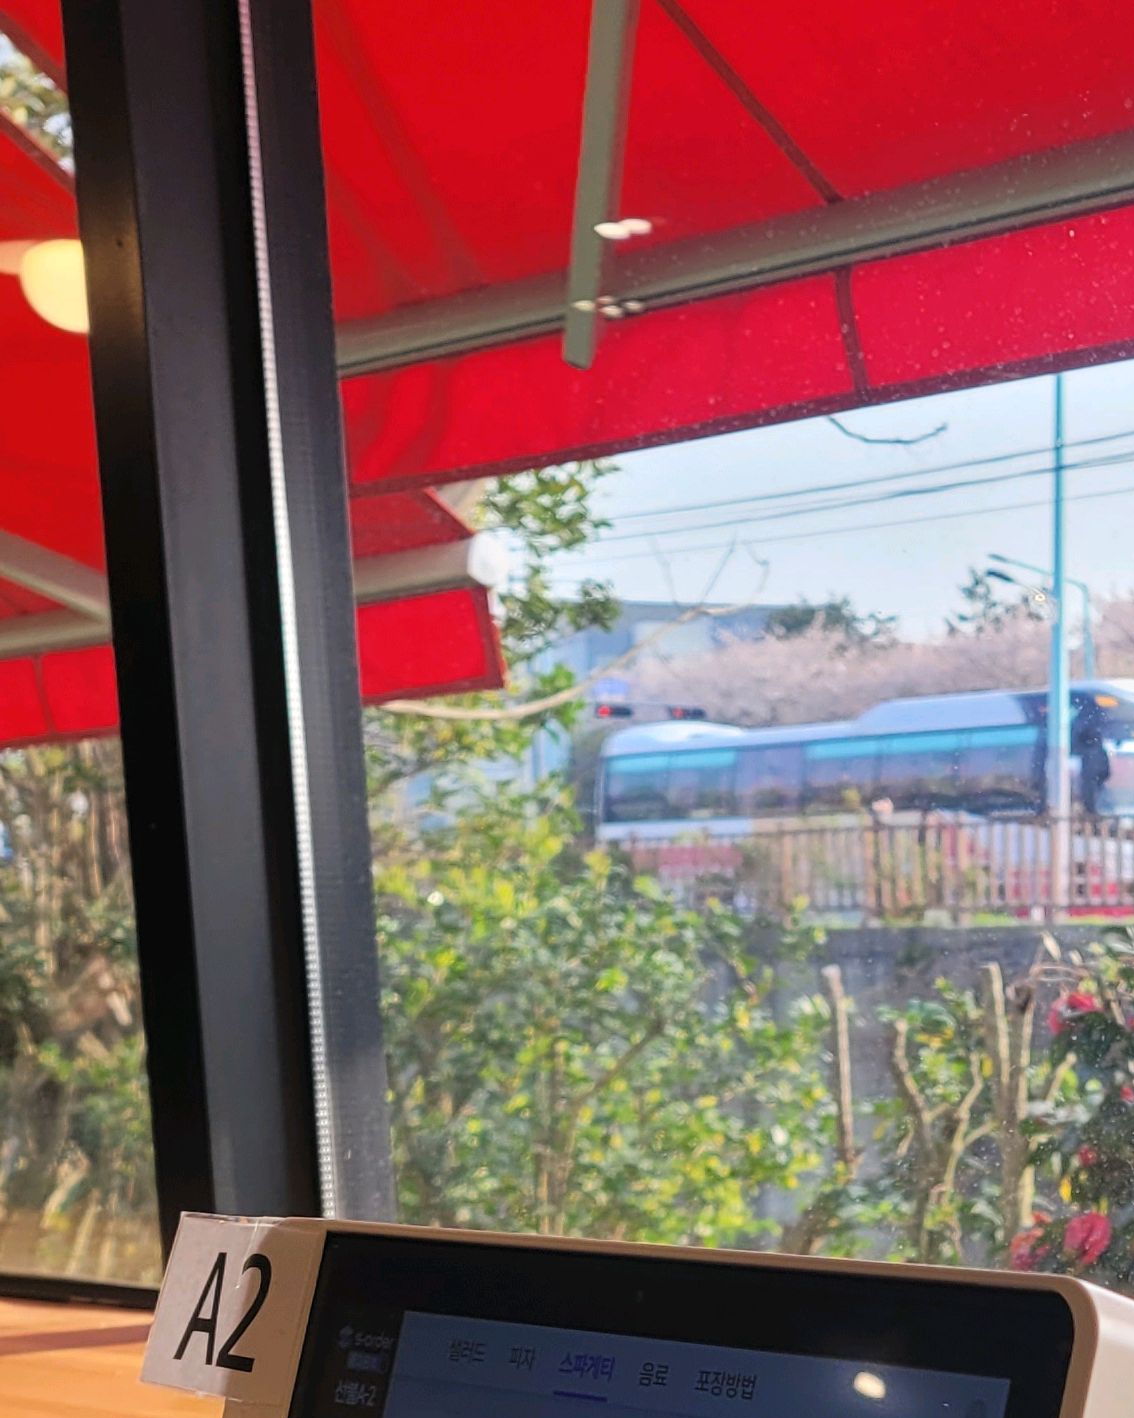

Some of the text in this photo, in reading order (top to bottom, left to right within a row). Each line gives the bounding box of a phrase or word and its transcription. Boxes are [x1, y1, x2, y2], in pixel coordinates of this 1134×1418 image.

[172, 1251, 274, 1374] A2
[448, 1338, 757, 1401] 샐러드 피자 스파게티 음료 포장방법
